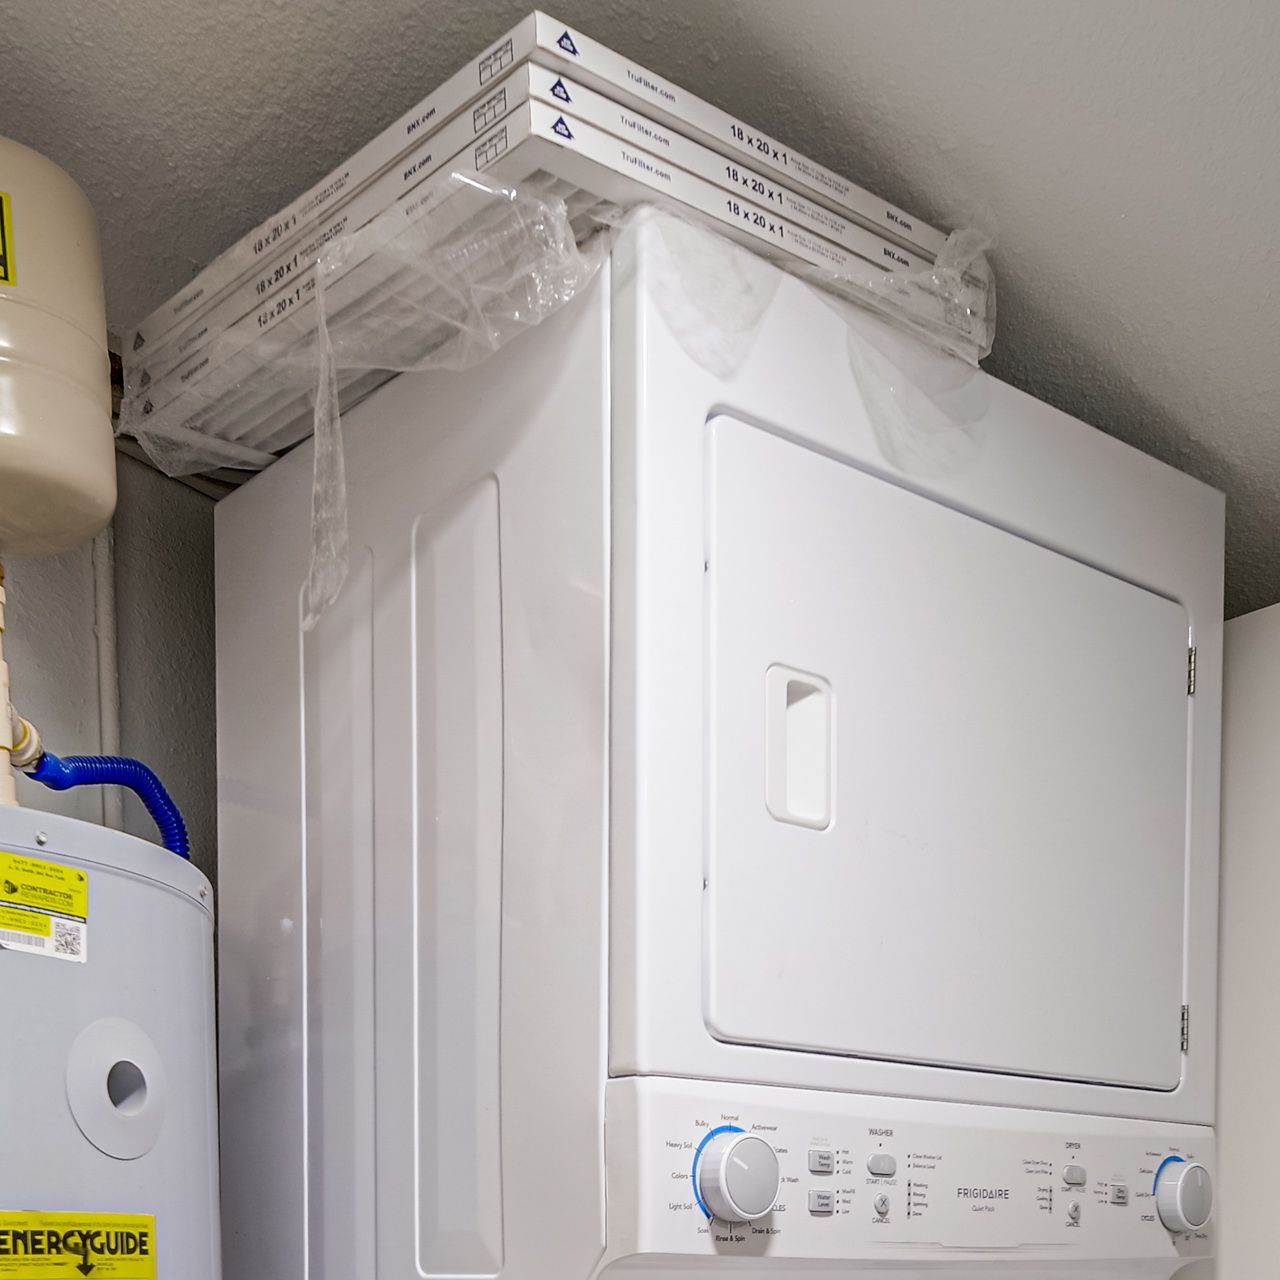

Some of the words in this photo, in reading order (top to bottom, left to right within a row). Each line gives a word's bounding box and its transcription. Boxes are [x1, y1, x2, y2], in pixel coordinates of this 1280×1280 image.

[627, 70, 675, 102] TruFilter.com
[407, 107, 436, 135] BNX.com
[620, 115, 670, 147] TruFilter.com
[731, 125, 744, 141] 18
[747, 136, 754, 147] x
[756, 139, 770, 155] 20
[772, 149, 779, 161] x
[782, 152, 787, 165] 1
[404, 154, 432, 181] BNX.com
[622, 151, 671, 182] TruFilter.com
[726, 166, 738, 182] 18
[742, 176, 748, 188] x
[751, 179, 765, 195] 20
[768, 189, 774, 200] x
[777, 192, 783, 205] 1
[727, 200, 739, 216] 18
[743, 210, 749, 221] x
[753, 213, 766, 228] 20
[769, 223, 775, 234] x
[779, 225, 784, 237] 1
[253, 240, 263, 255] 18
[265, 236, 270, 245] x
[272, 223, 282, 240] 20
[284, 221, 289, 232] x
[292, 214, 296, 225] 1
[256, 280, 266, 295] 18
[267, 276, 272, 288] x
[274, 266, 284, 282] 20
[286, 262, 292, 274] x
[293, 254, 298, 268] 1
[270, 310, 275, 320] x
[276, 299, 286, 315] 20
[288, 297, 294, 307] x
[296, 288, 300, 301] 1
[20, 883, 73, 900] CONTRACTOR
[666, 1141, 682, 1149] Heavy
[868, 1128, 893, 1137] WASHER
[957, 1188, 1009, 1199] FRIGIDAIRE
[735, 1235, 745, 1243] Spin
